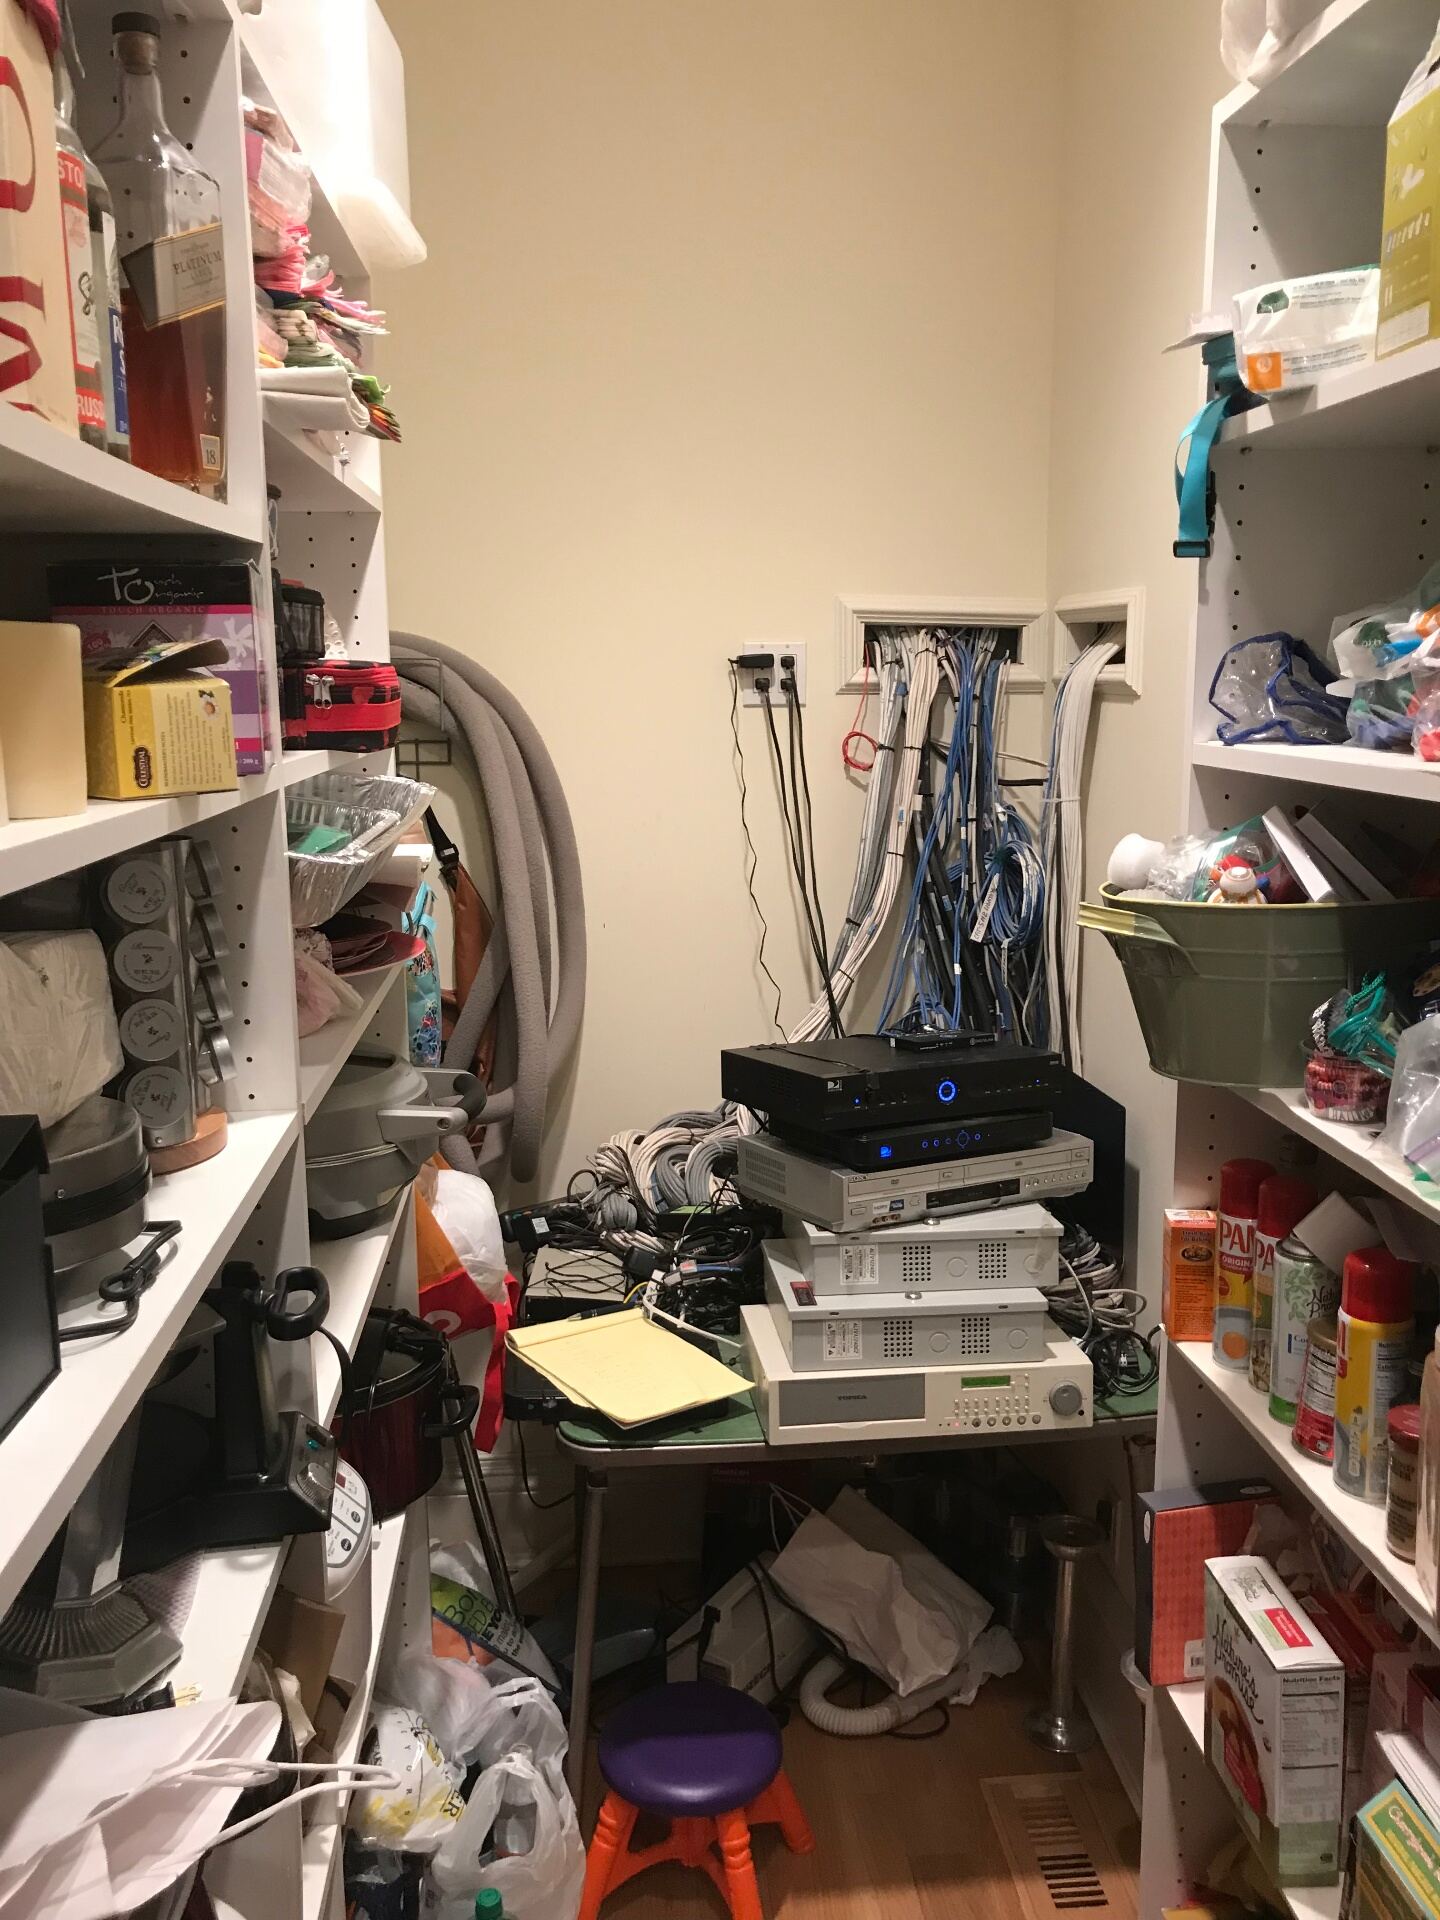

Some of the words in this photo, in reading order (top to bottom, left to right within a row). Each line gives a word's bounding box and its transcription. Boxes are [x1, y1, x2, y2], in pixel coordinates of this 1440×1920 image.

[173, 250, 223, 275] PLATINUM
[206, 449, 216, 465] 18
[139, 751, 148, 787] CELESTIAL
[1222, 1255, 1252, 1267] ORIGIN
